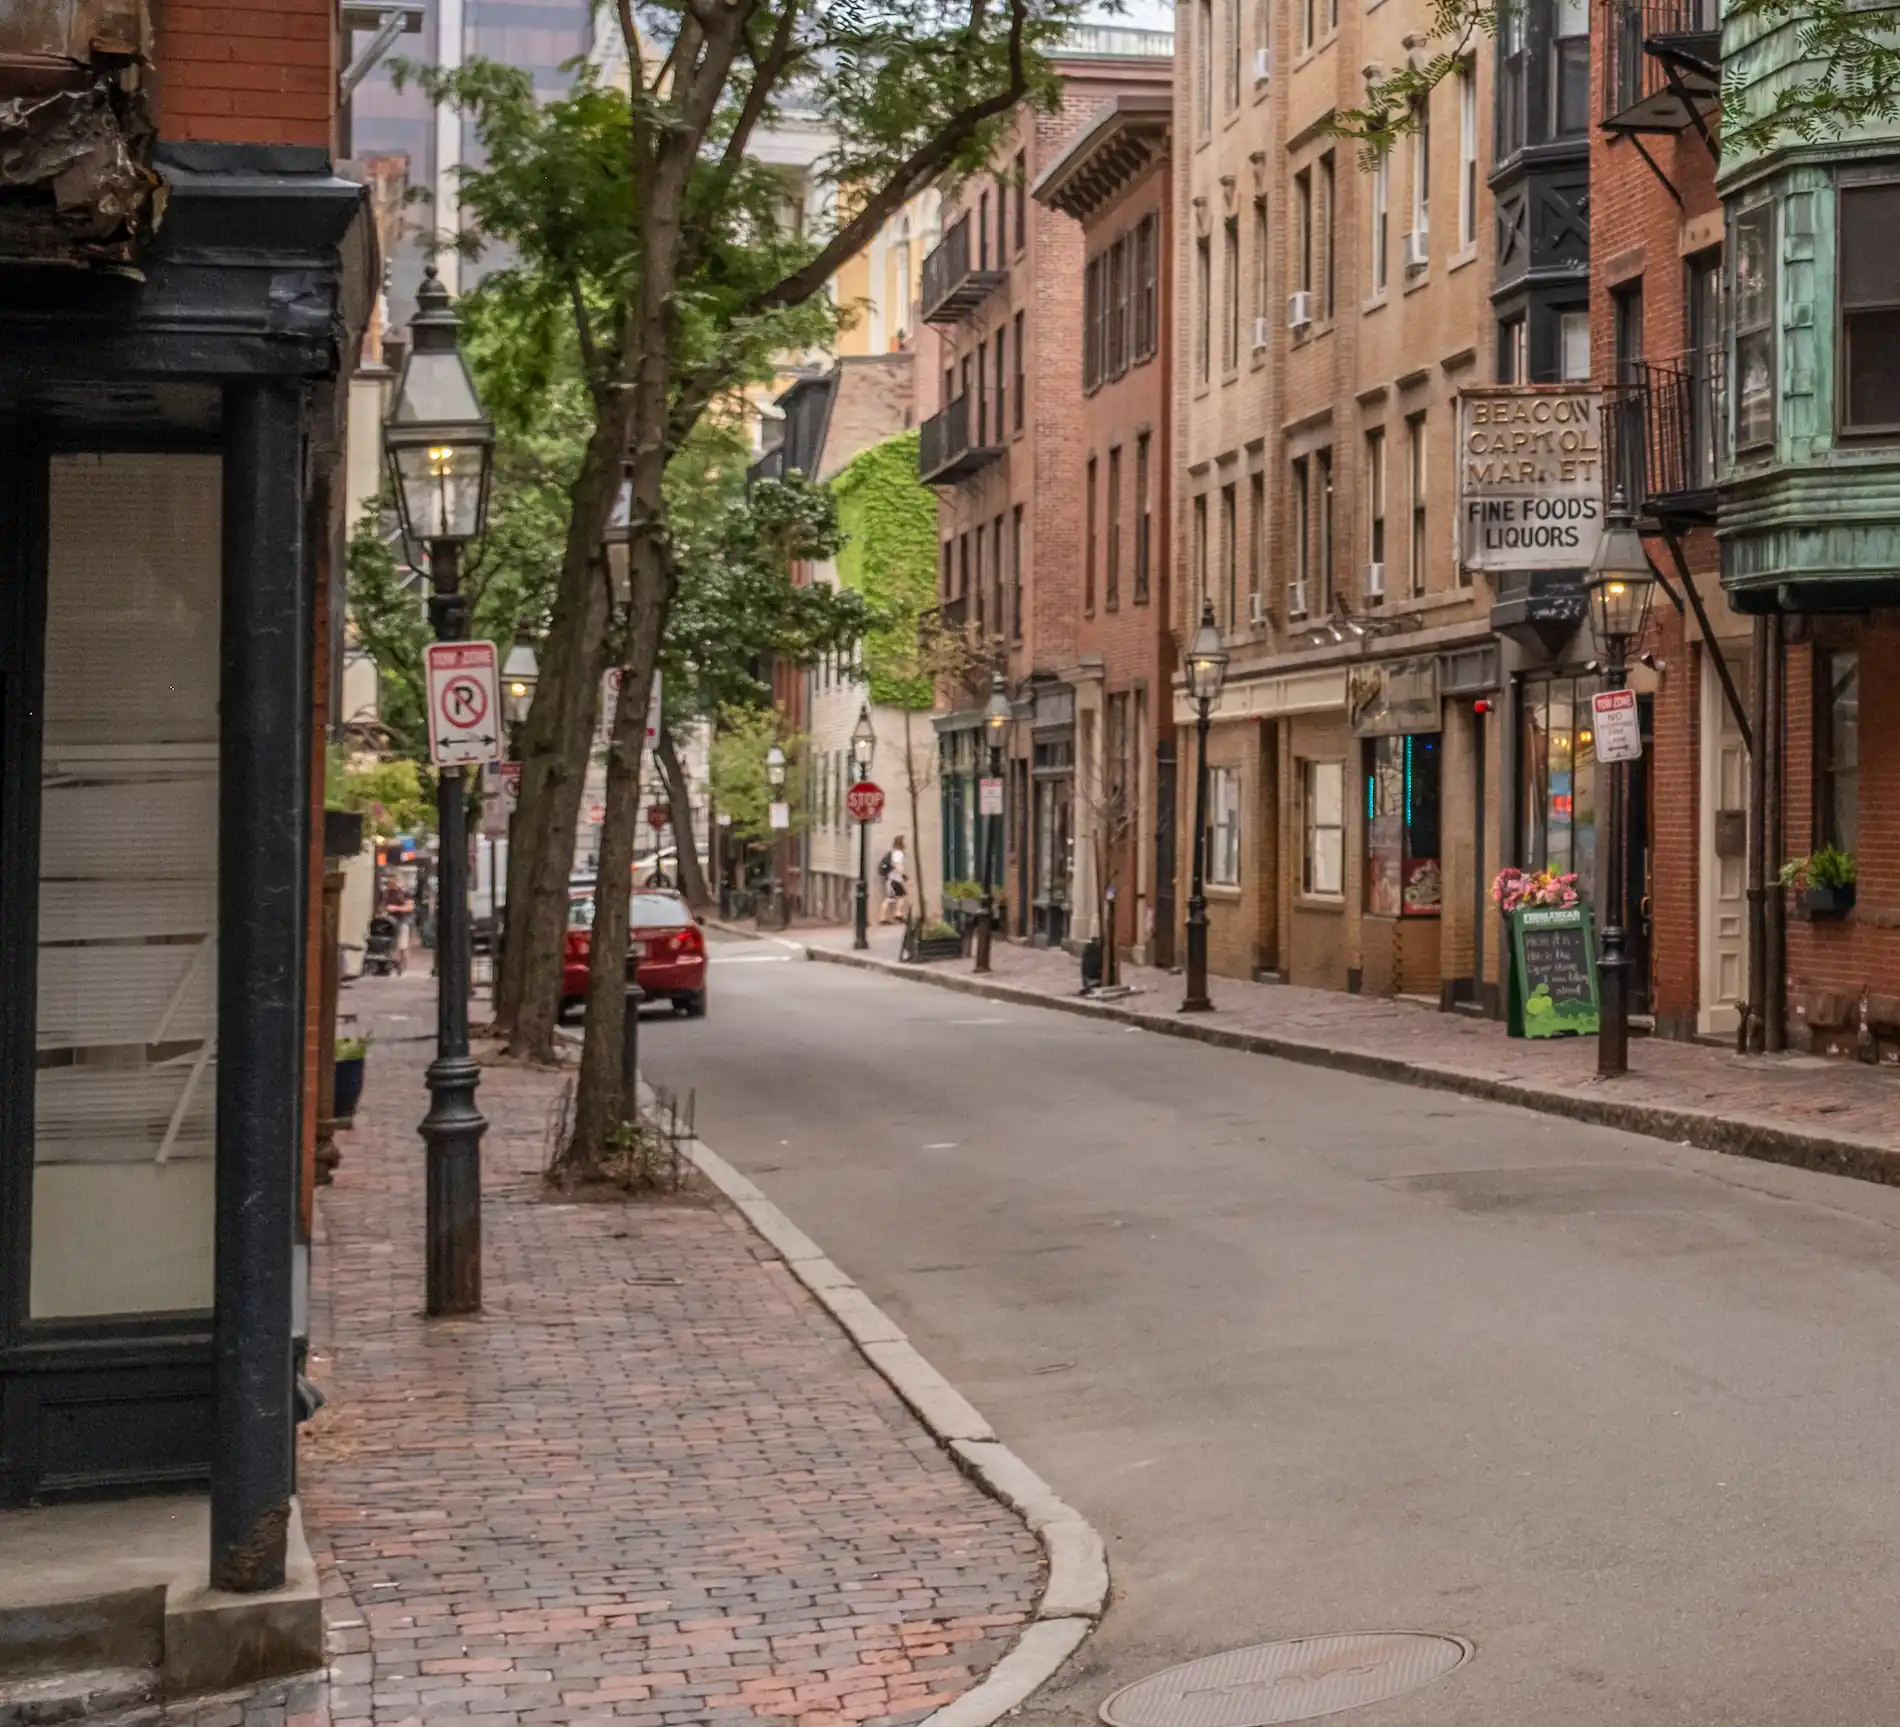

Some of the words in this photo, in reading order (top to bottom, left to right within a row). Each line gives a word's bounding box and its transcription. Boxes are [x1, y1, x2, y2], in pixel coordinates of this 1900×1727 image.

[1472, 398, 1590, 426] BEACON
[1468, 429, 1598, 455] CAPITOL
[1467, 459, 1598, 485] MARET
[1469, 500, 1515, 522] FINE
[1523, 498, 1597, 520] FOODS
[1486, 526, 1579, 549] LIQUORS
[1607, 711, 1623, 722] NO
[848, 791, 882, 806] STOP
